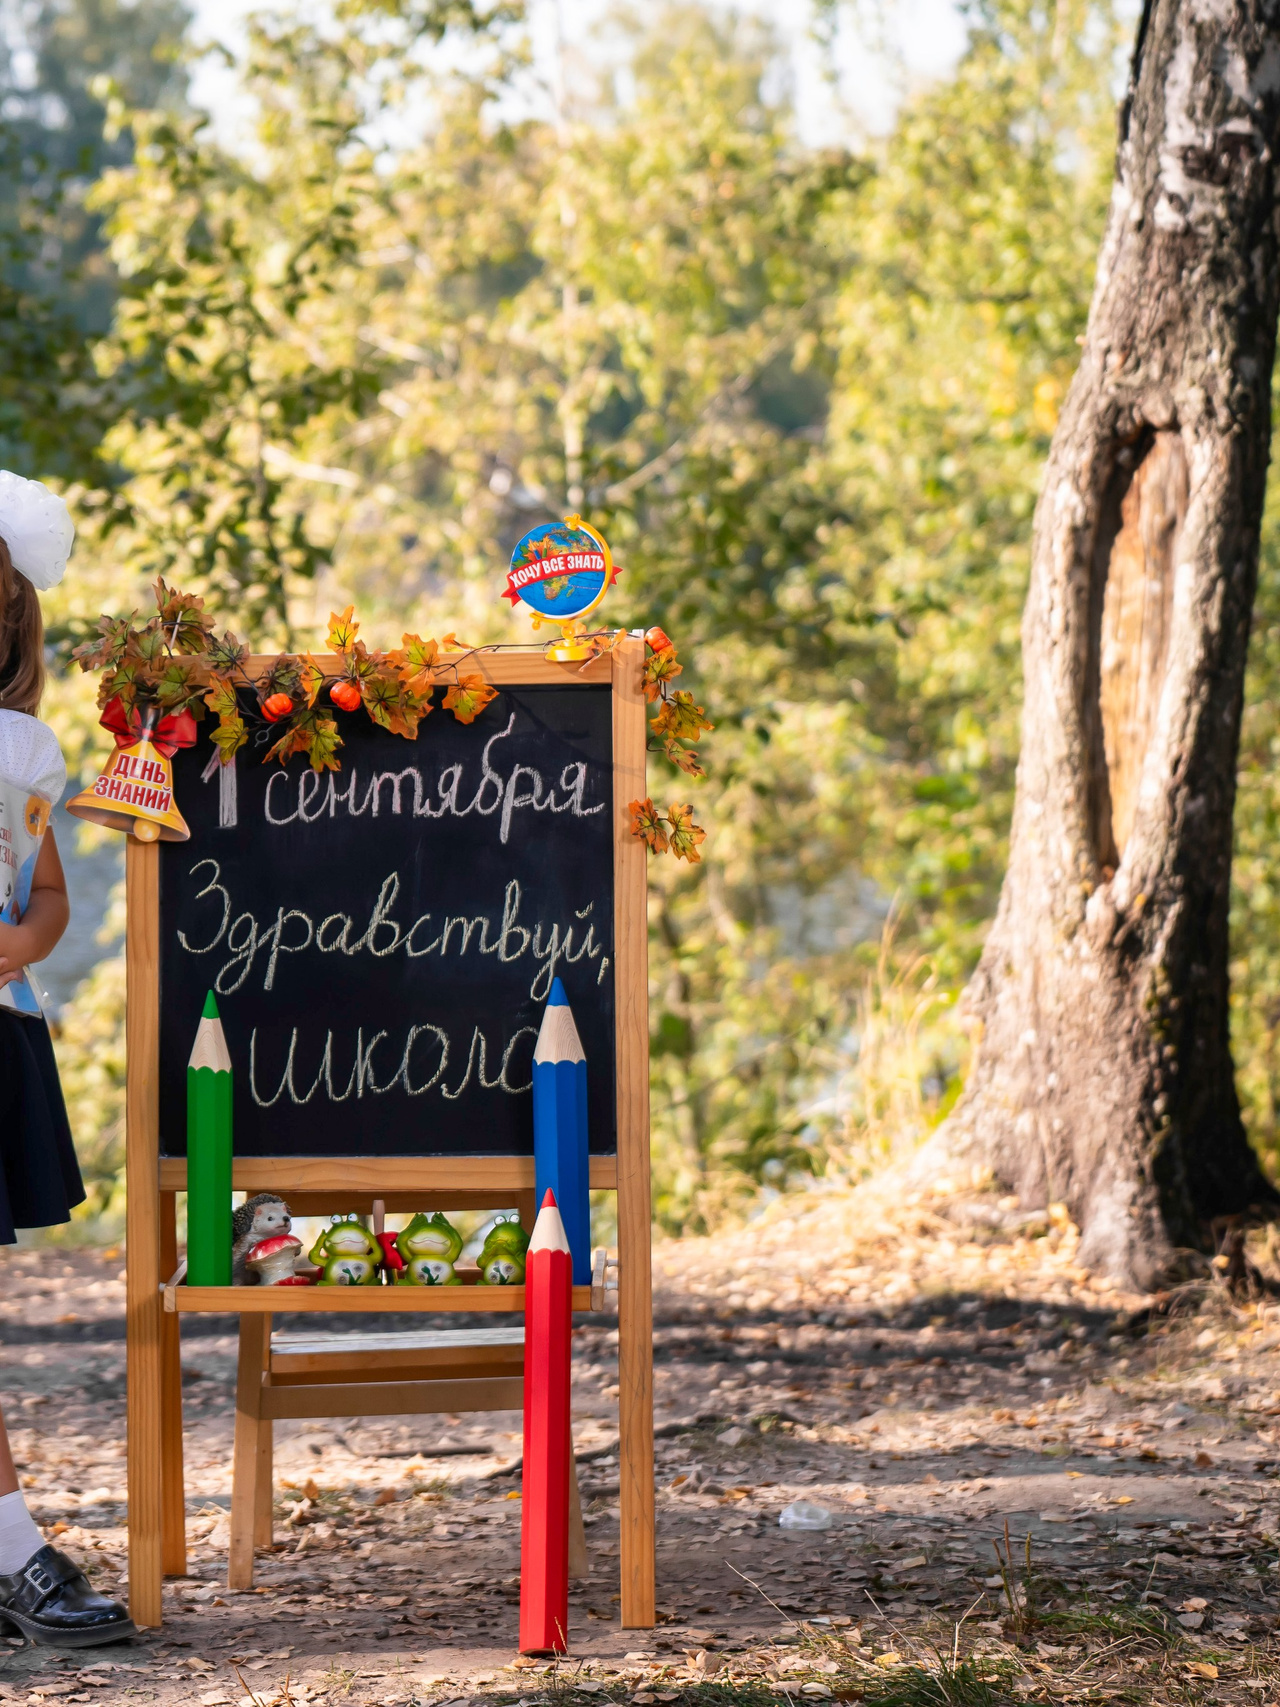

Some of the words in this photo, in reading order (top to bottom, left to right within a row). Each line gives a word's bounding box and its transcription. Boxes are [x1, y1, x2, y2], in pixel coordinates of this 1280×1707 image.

[509, 562, 541, 588] ХОЧУ
[541, 556, 565, 574] ВСЕ
[567, 554, 604, 569] ЗНАТЬ
[112, 753, 167, 784] ДЕНЬ
[200, 742, 238, 829] 1
[264, 712, 606, 844] сентября
[94, 775, 172, 812] ЗНАНИЙ
[177, 858, 609, 1001] Здравствуй,
